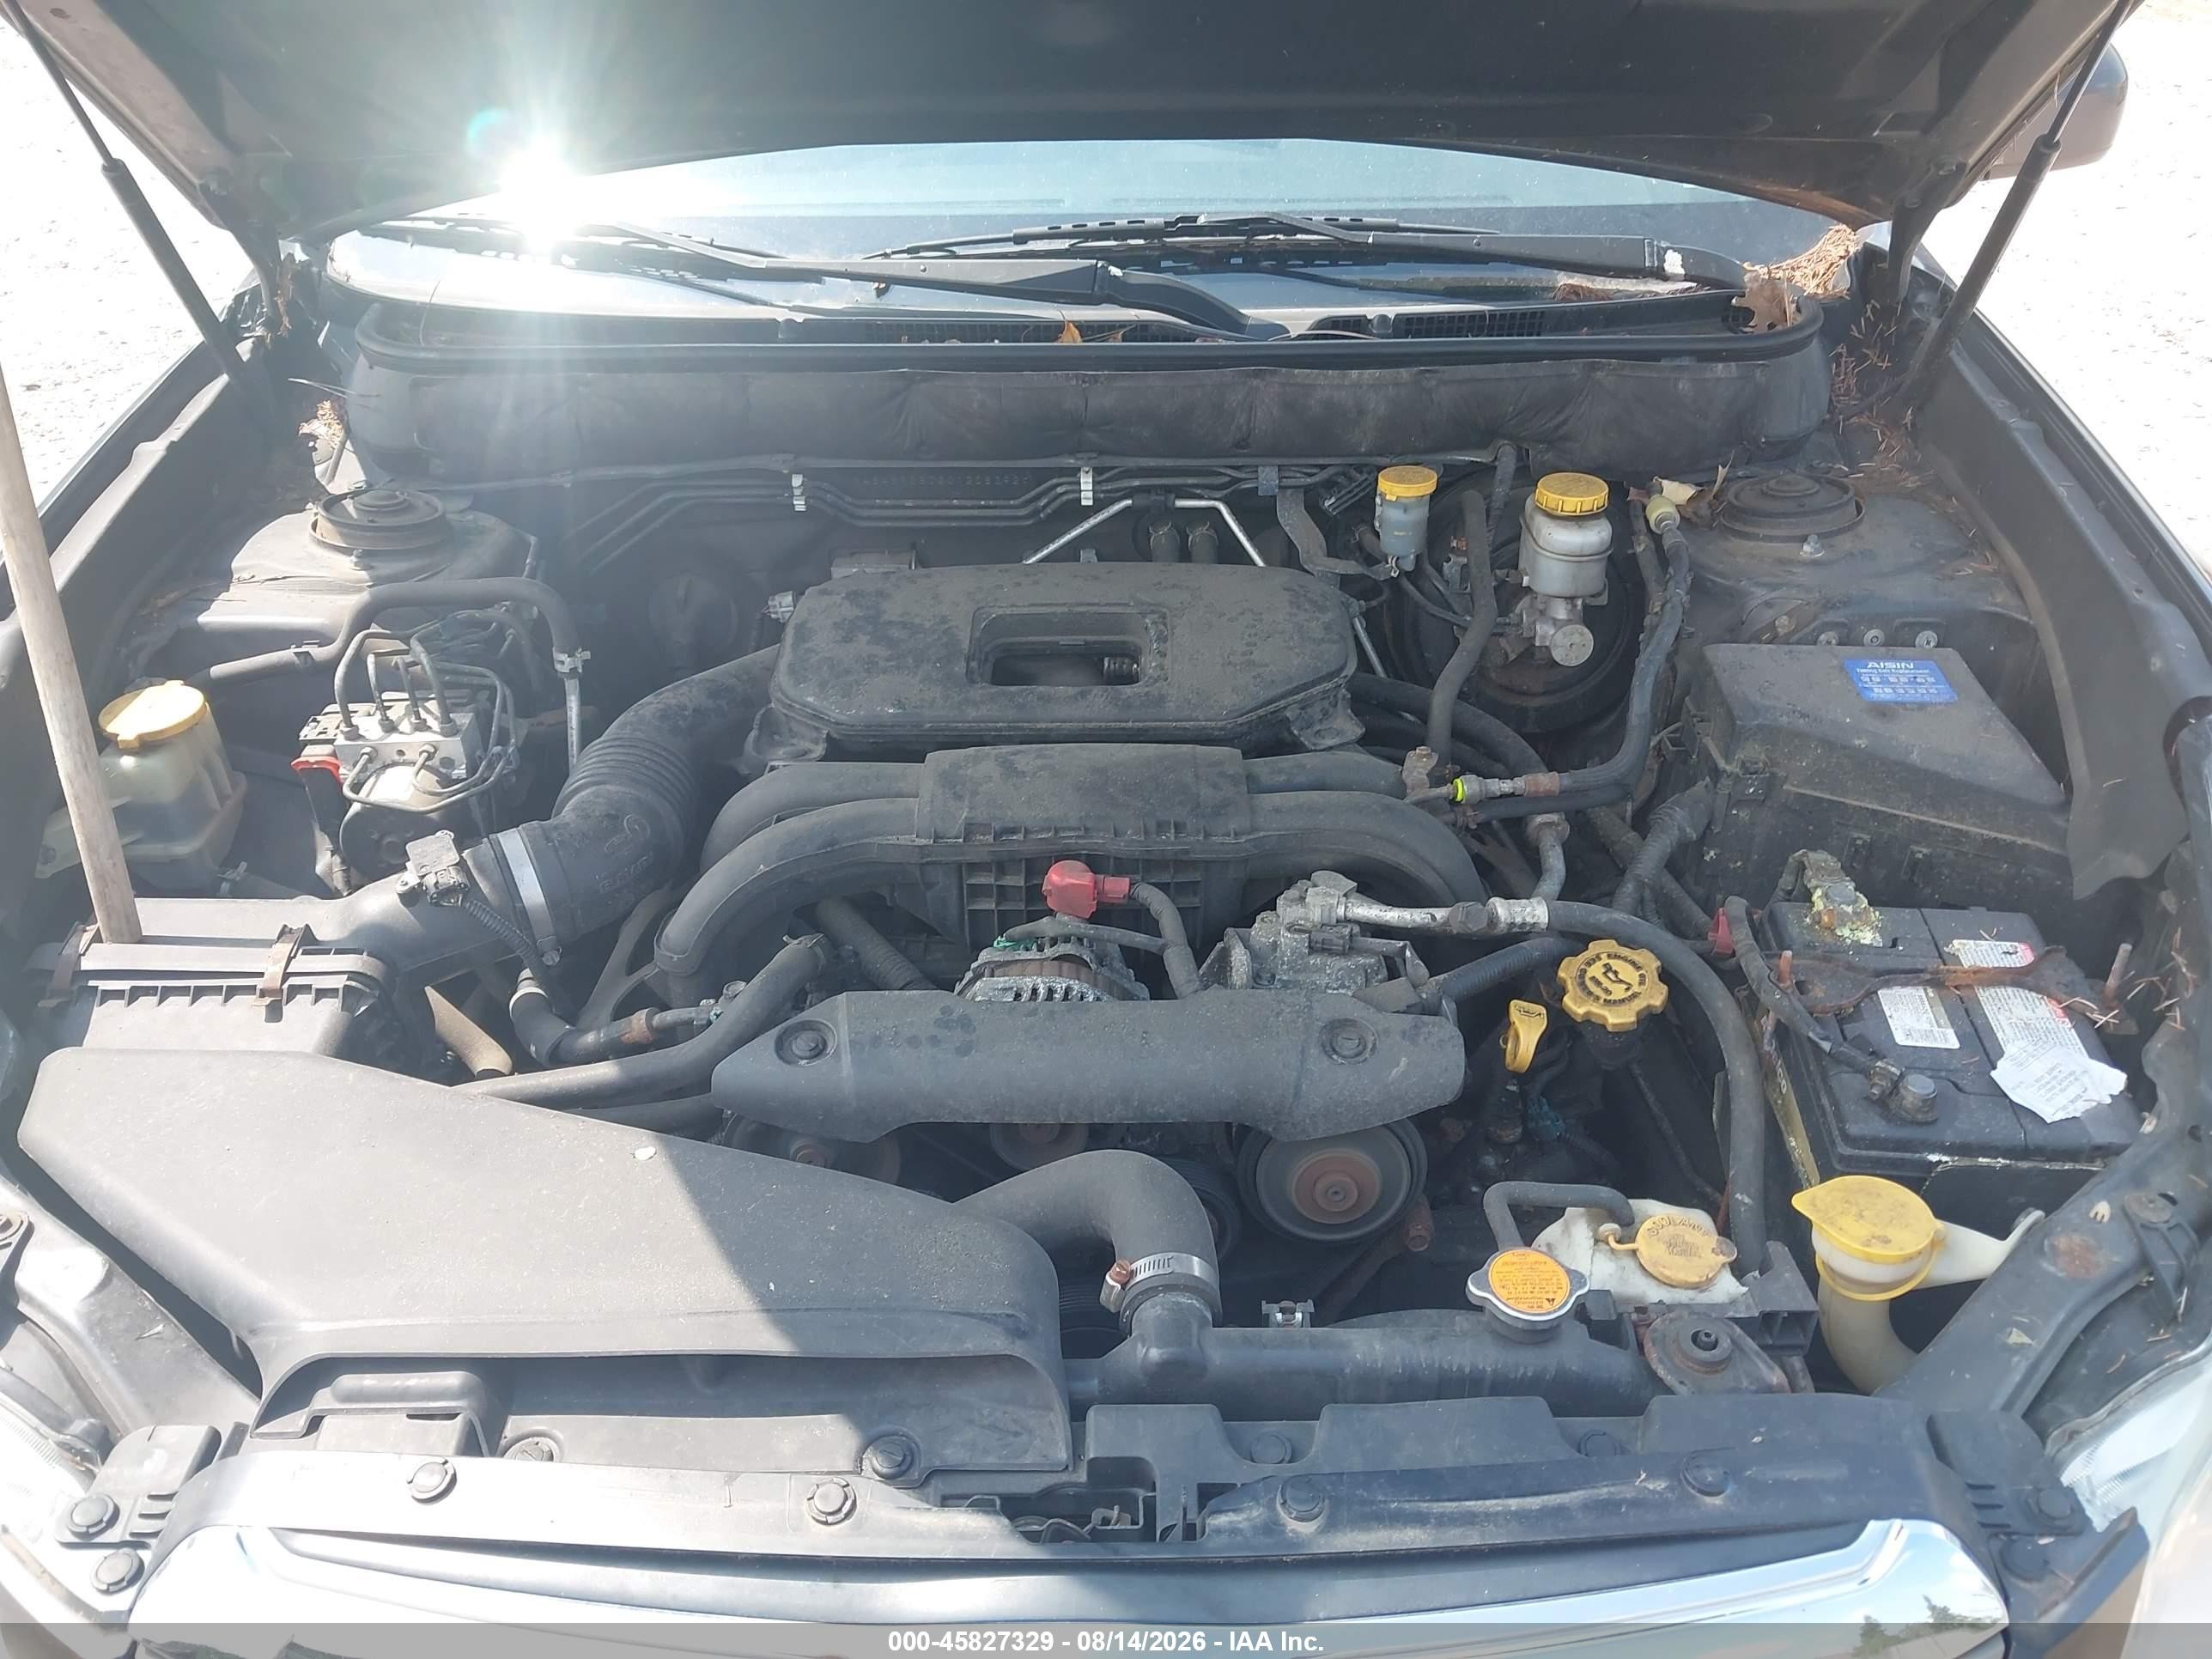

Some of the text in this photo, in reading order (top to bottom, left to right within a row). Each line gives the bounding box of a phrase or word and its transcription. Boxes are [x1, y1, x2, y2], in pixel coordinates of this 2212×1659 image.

[1607, 953, 1643, 972] ENGINE
[1585, 955, 1601, 968] SEE
[1603, 992, 1642, 1004] MANUAL
[1646, 1215, 1713, 1237] COOLANT
